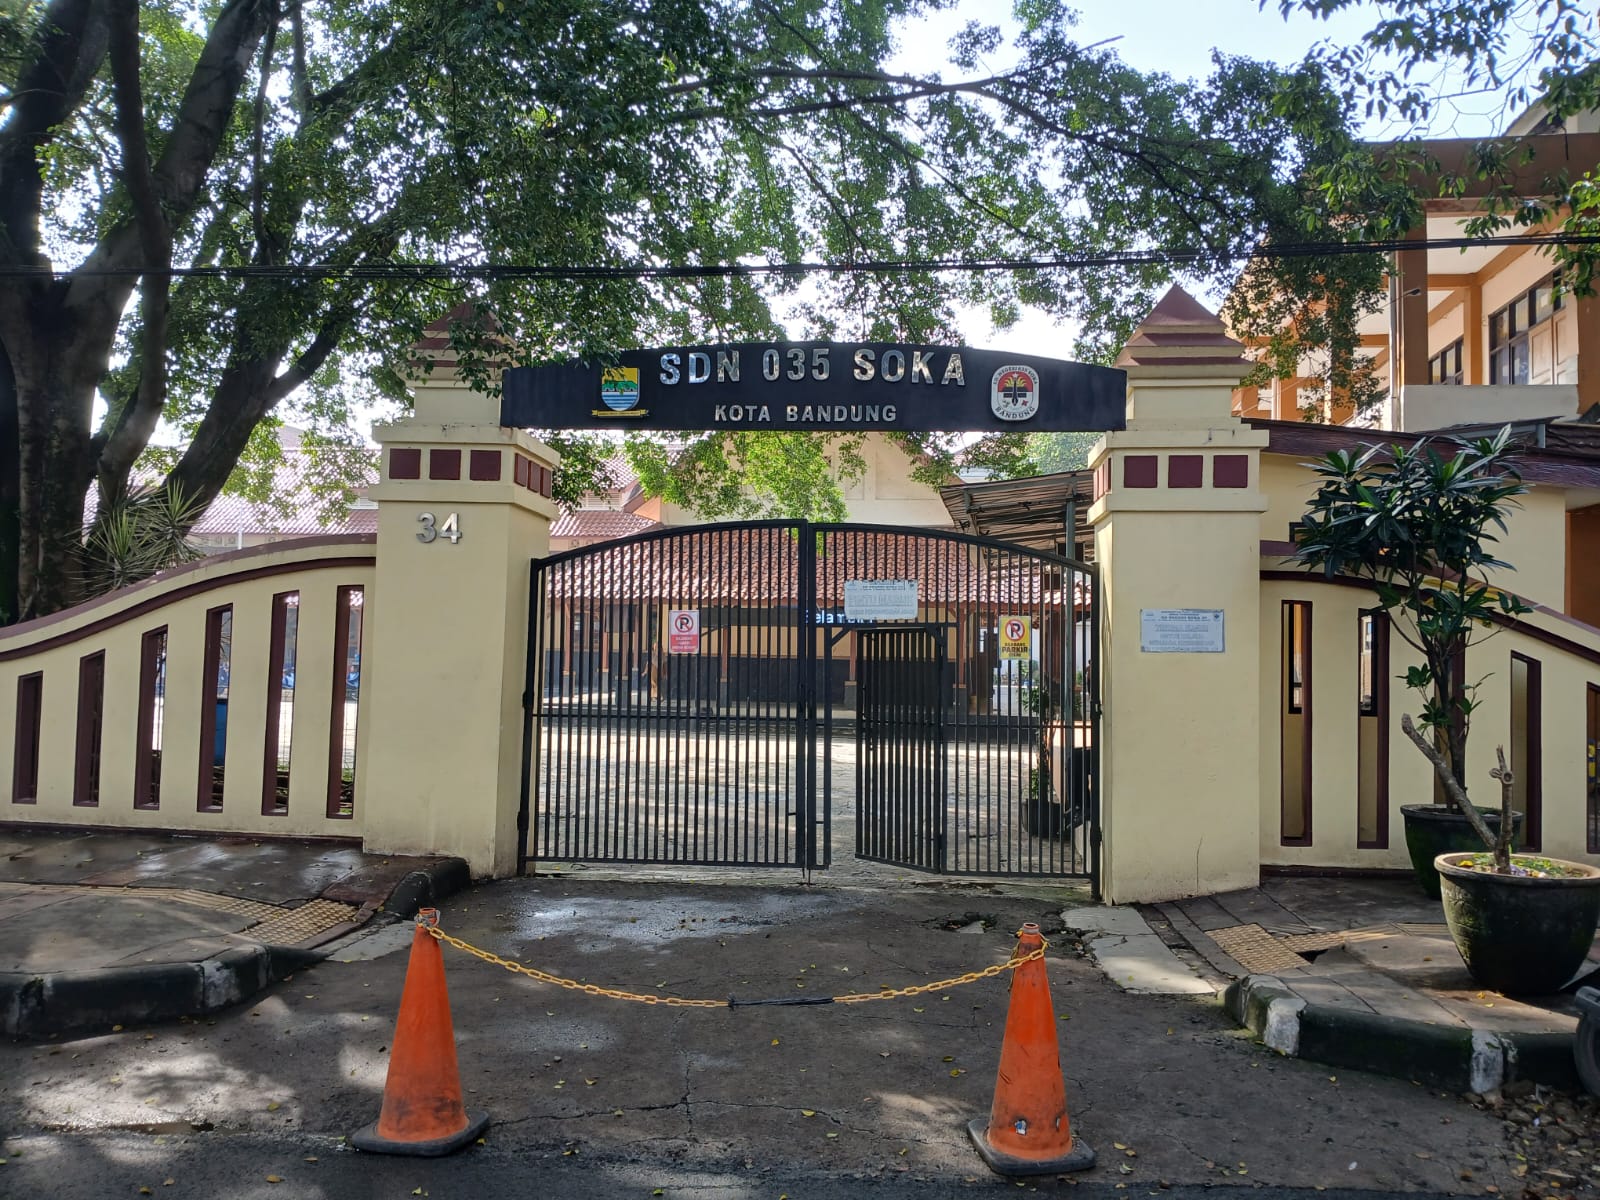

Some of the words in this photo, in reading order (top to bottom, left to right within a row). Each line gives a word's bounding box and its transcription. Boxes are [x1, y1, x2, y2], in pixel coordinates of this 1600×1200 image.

[659, 350, 740, 385] SDN
[762, 348, 831, 381] 035
[853, 348, 966, 386] SOKA
[714, 404, 771, 422] KOTA
[786, 404, 897, 422] BANDUNG
[995, 406, 1036, 418] BANDUNG
[416, 512, 463, 544] 34
